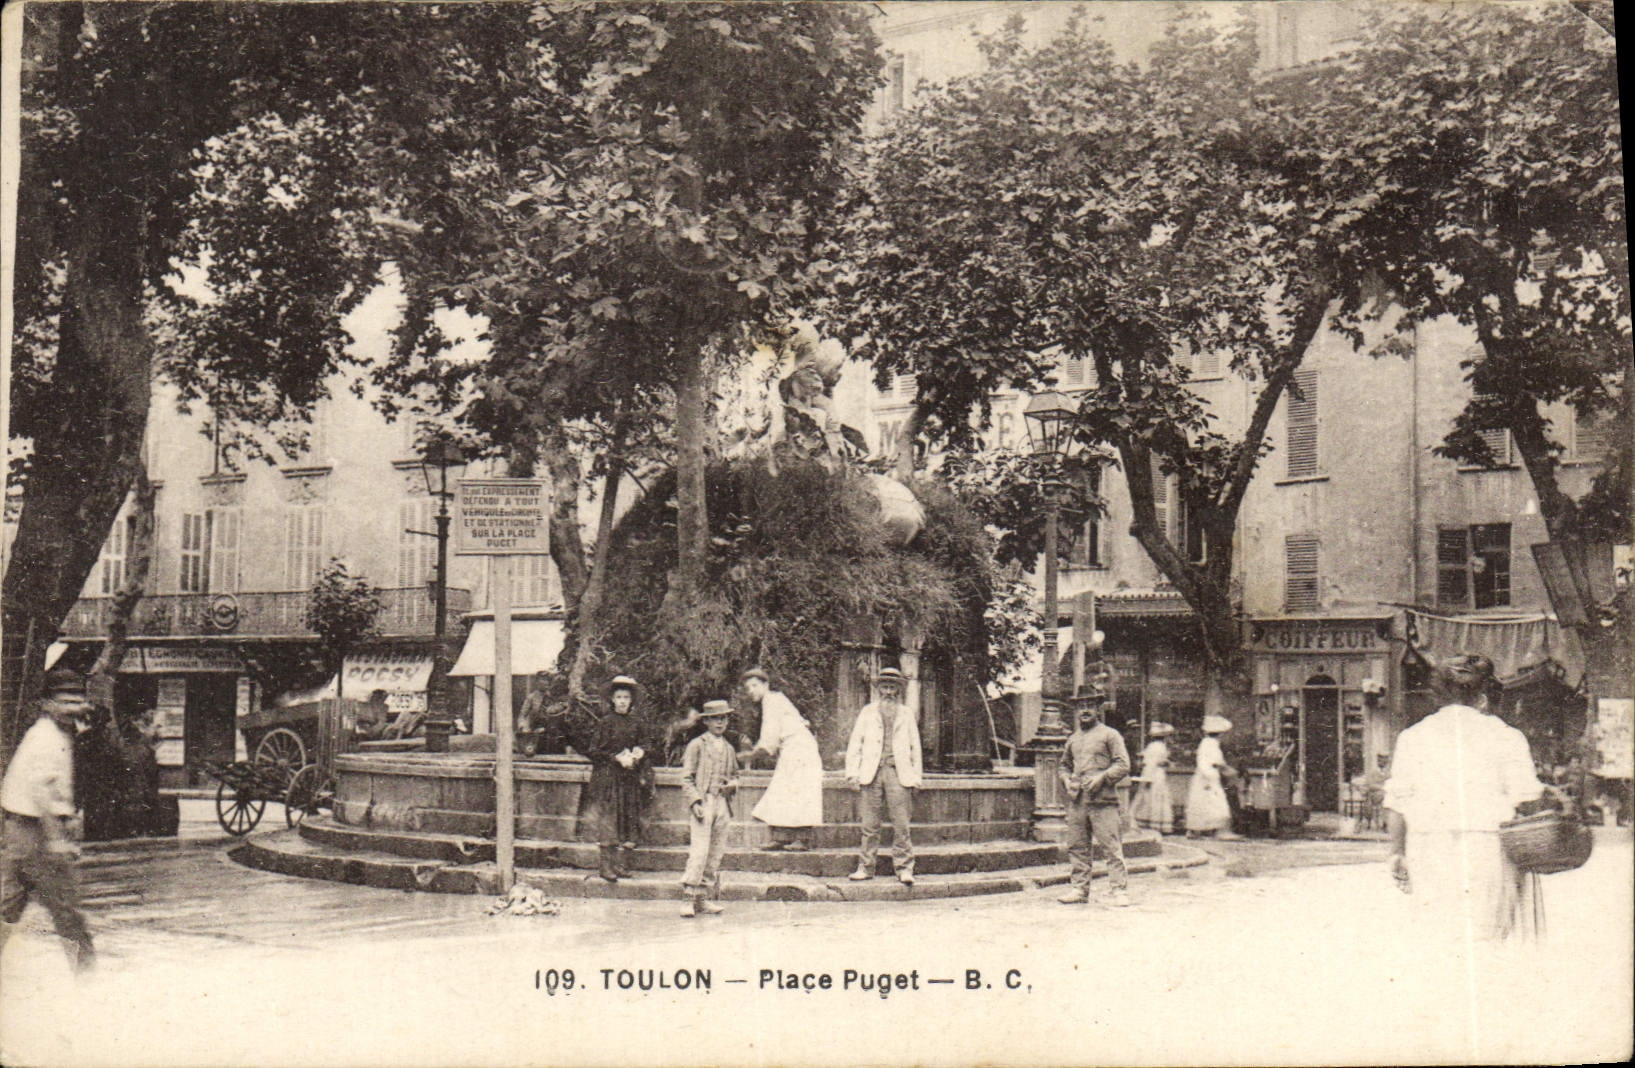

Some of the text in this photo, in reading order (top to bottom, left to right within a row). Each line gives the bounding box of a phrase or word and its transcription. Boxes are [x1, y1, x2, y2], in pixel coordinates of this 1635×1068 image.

[515, 497, 540, 506] TOUT
[464, 519, 475, 527] ET
[472, 529, 537, 538] SUR LA PLACE
[487, 539, 517, 547] PUGET
[1264, 630, 1376, 648] COIFFEUR
